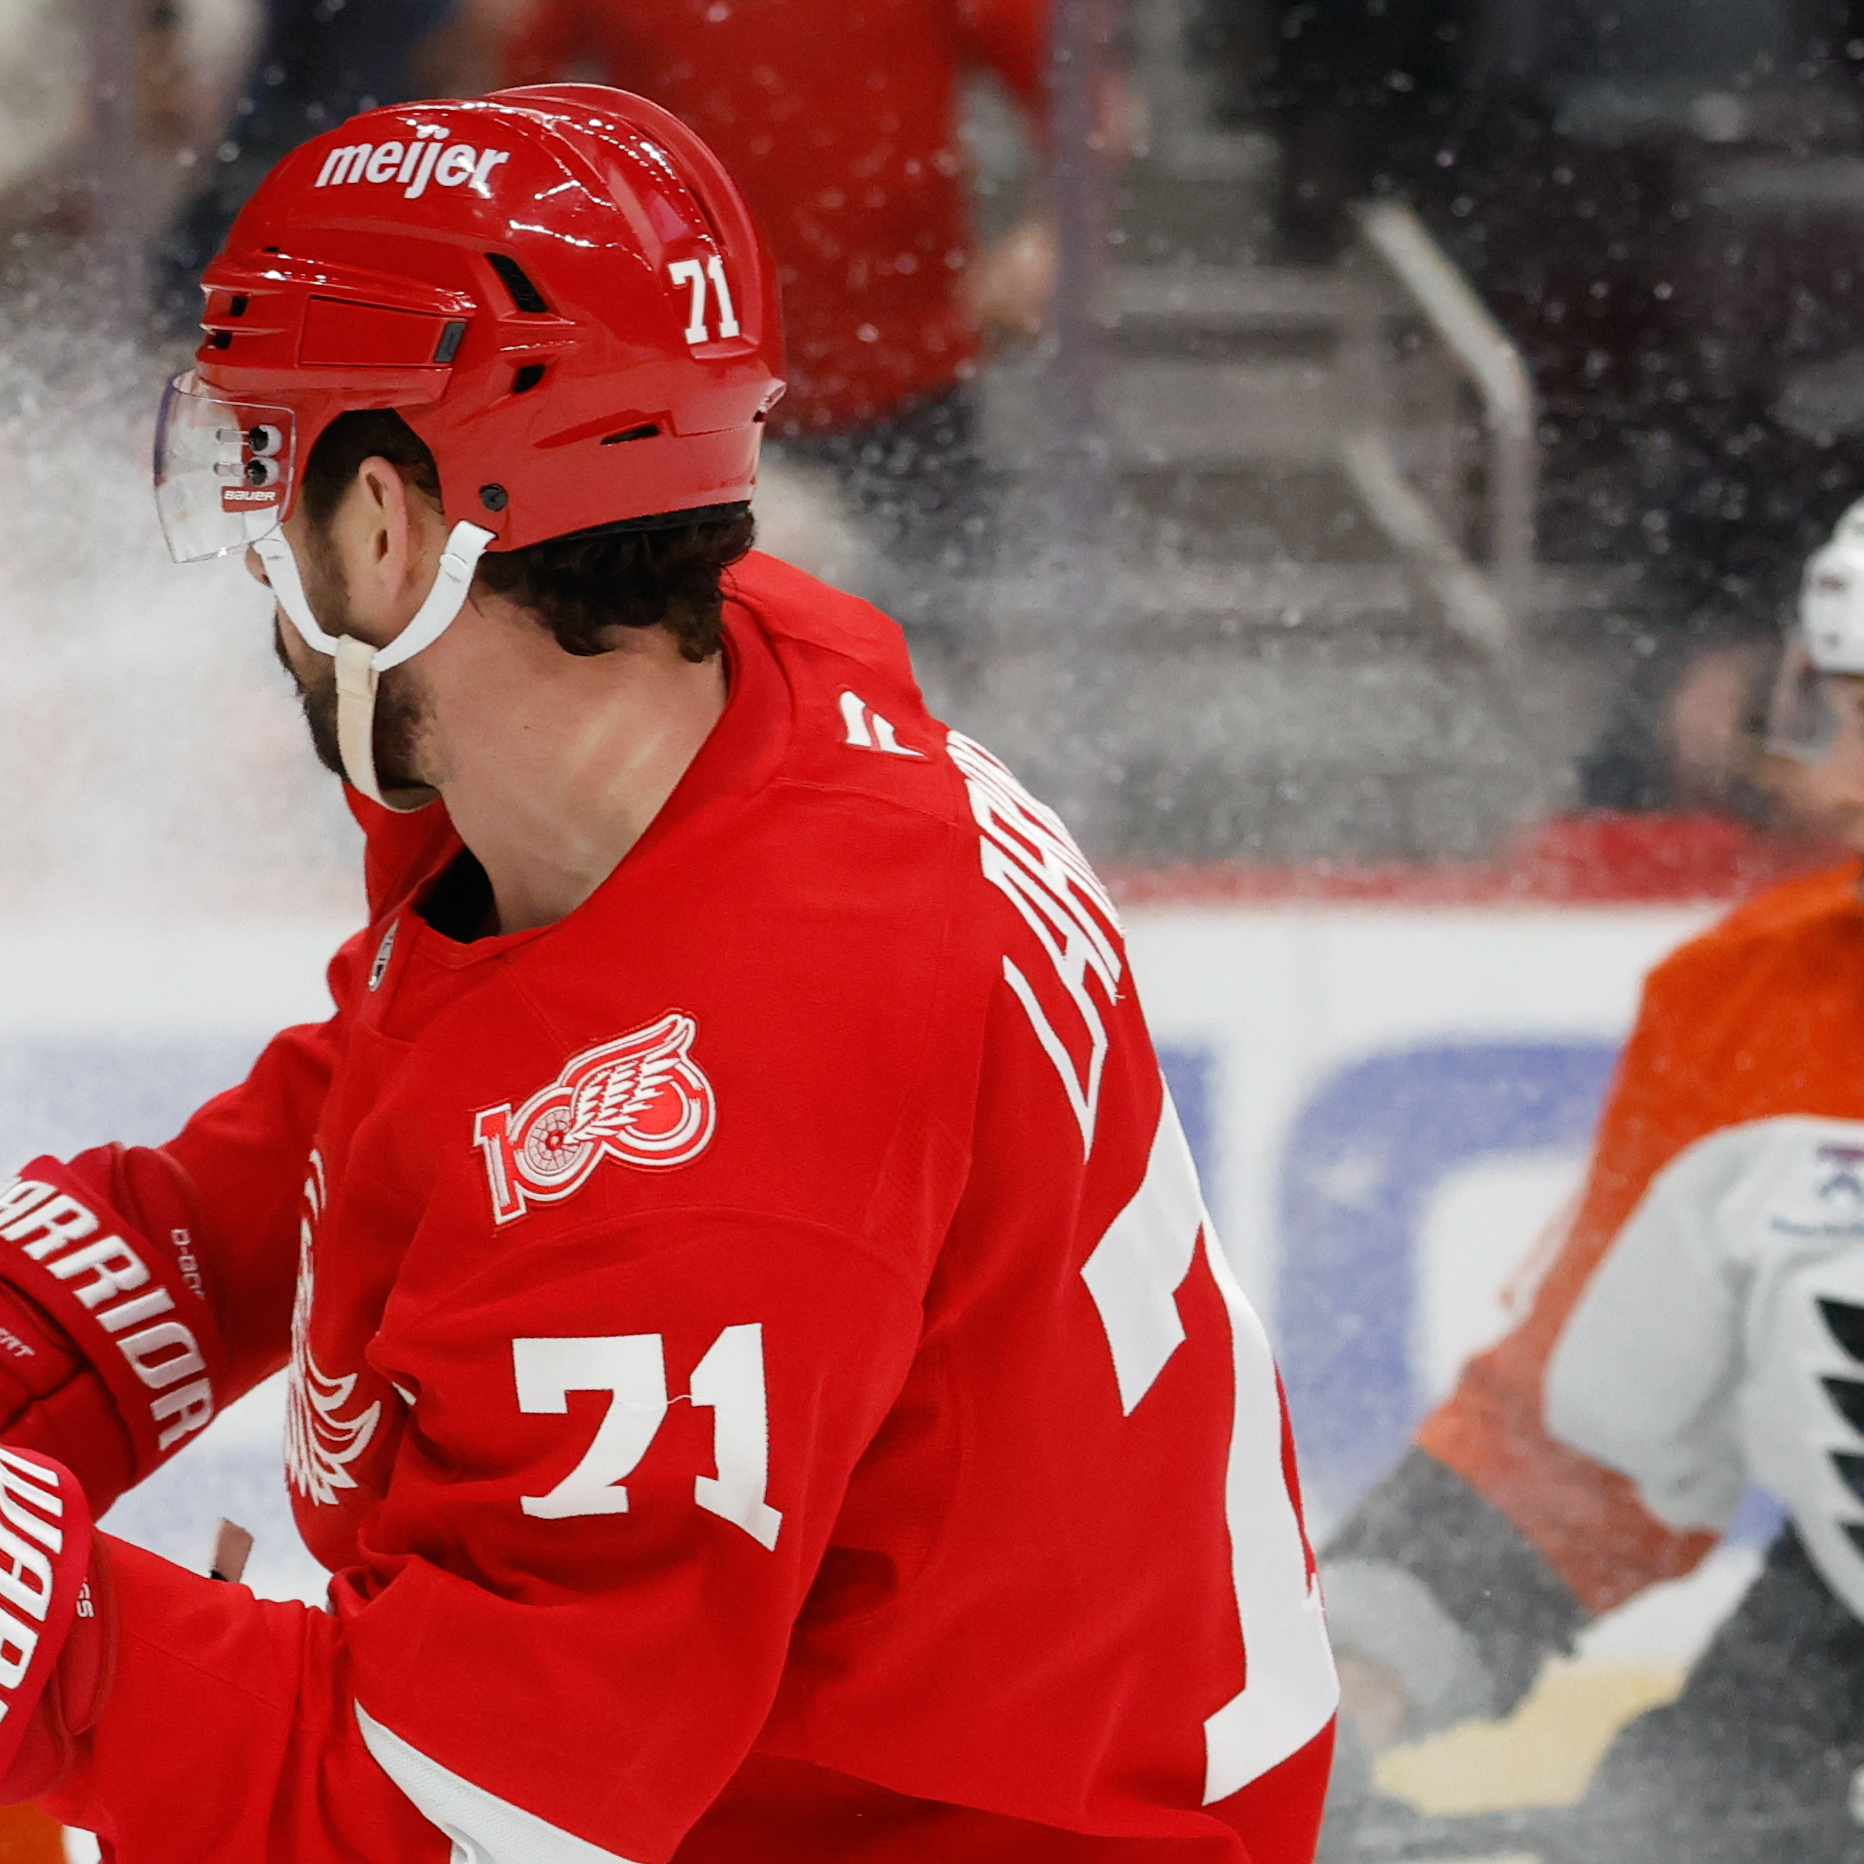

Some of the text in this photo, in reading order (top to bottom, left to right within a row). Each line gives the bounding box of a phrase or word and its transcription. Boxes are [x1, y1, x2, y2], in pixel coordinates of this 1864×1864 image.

[314, 125, 510, 199] meijer
[669, 255, 740, 345] 71
[223, 489, 277, 502] BAUER
[511, 1321, 783, 1552] 71
